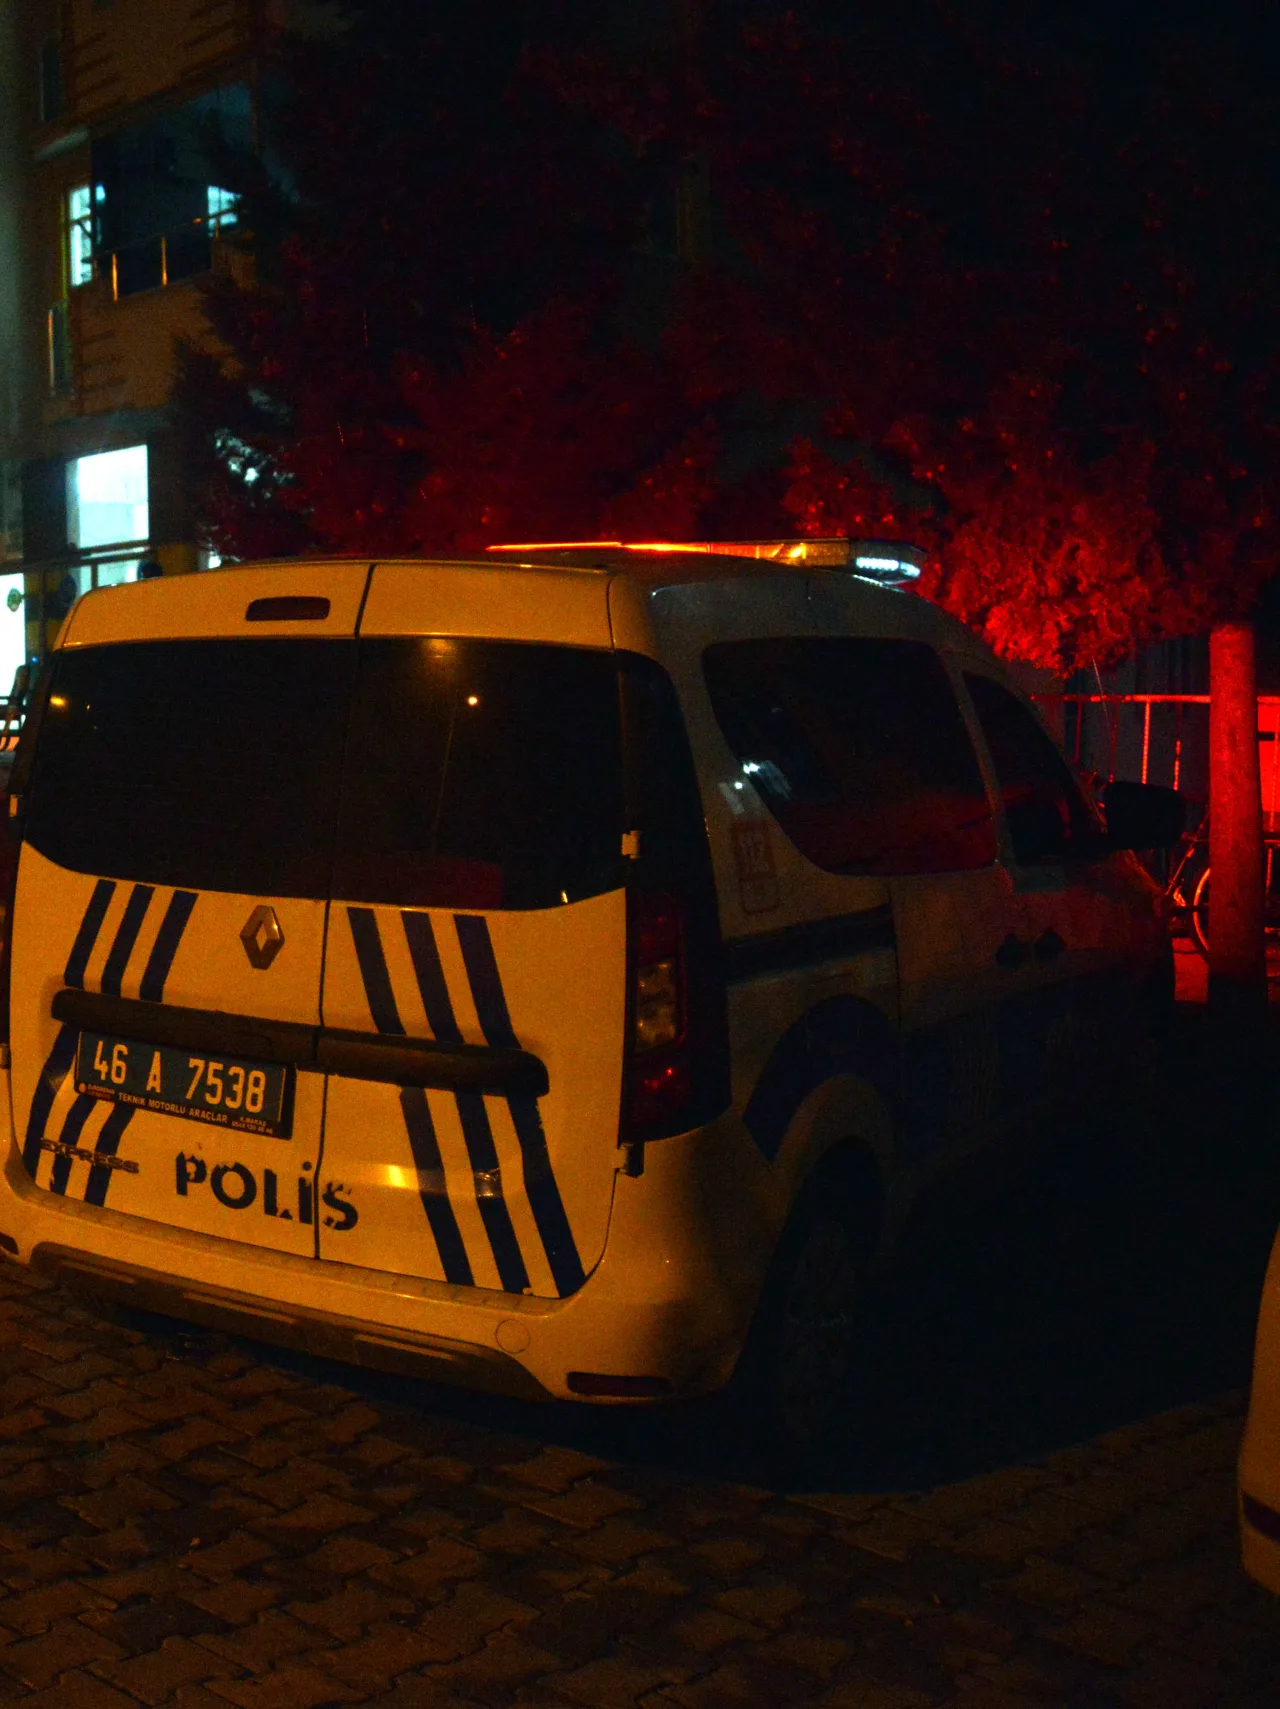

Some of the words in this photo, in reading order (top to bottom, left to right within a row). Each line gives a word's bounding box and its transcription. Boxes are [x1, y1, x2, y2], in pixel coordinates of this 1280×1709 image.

[93, 1040, 129, 1085] 46
[145, 1050, 162, 1094] A
[185, 1058, 267, 1114] 7538
[148, 1099, 186, 1114] MOTORLU
